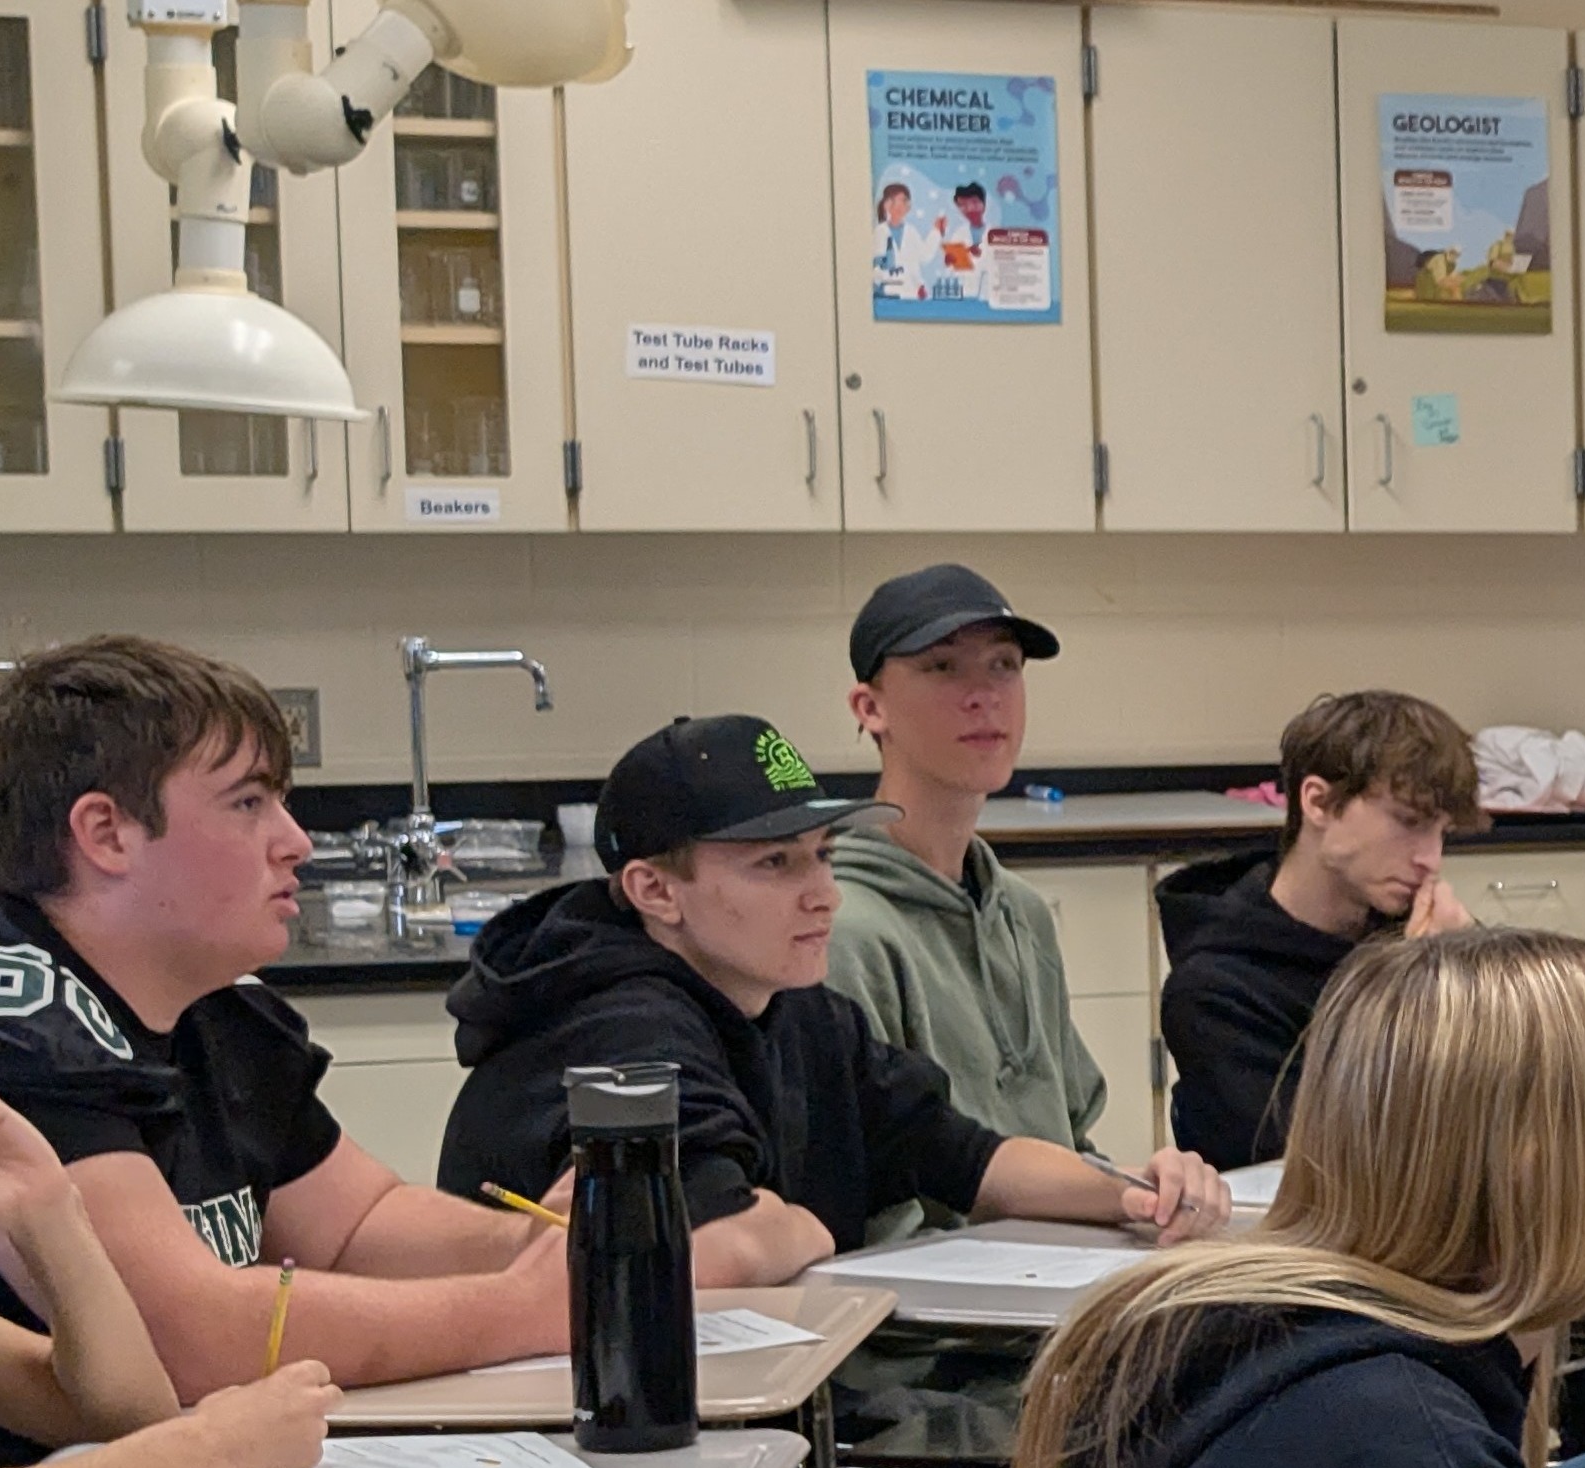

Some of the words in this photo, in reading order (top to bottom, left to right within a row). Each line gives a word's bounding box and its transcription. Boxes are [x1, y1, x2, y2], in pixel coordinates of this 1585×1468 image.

[886, 87, 994, 110] CHEMICAL
[887, 111, 992, 132] ENGINEER
[1392, 113, 1502, 136] GEOLOGIST
[633, 330, 668, 347] Test
[673, 333, 713, 349] Tube
[718, 335, 769, 353] Racks
[638, 356, 669, 371] and
[676, 358, 709, 373] Test
[714, 359, 764, 375] Tubes
[420, 500, 491, 515] Beakers
